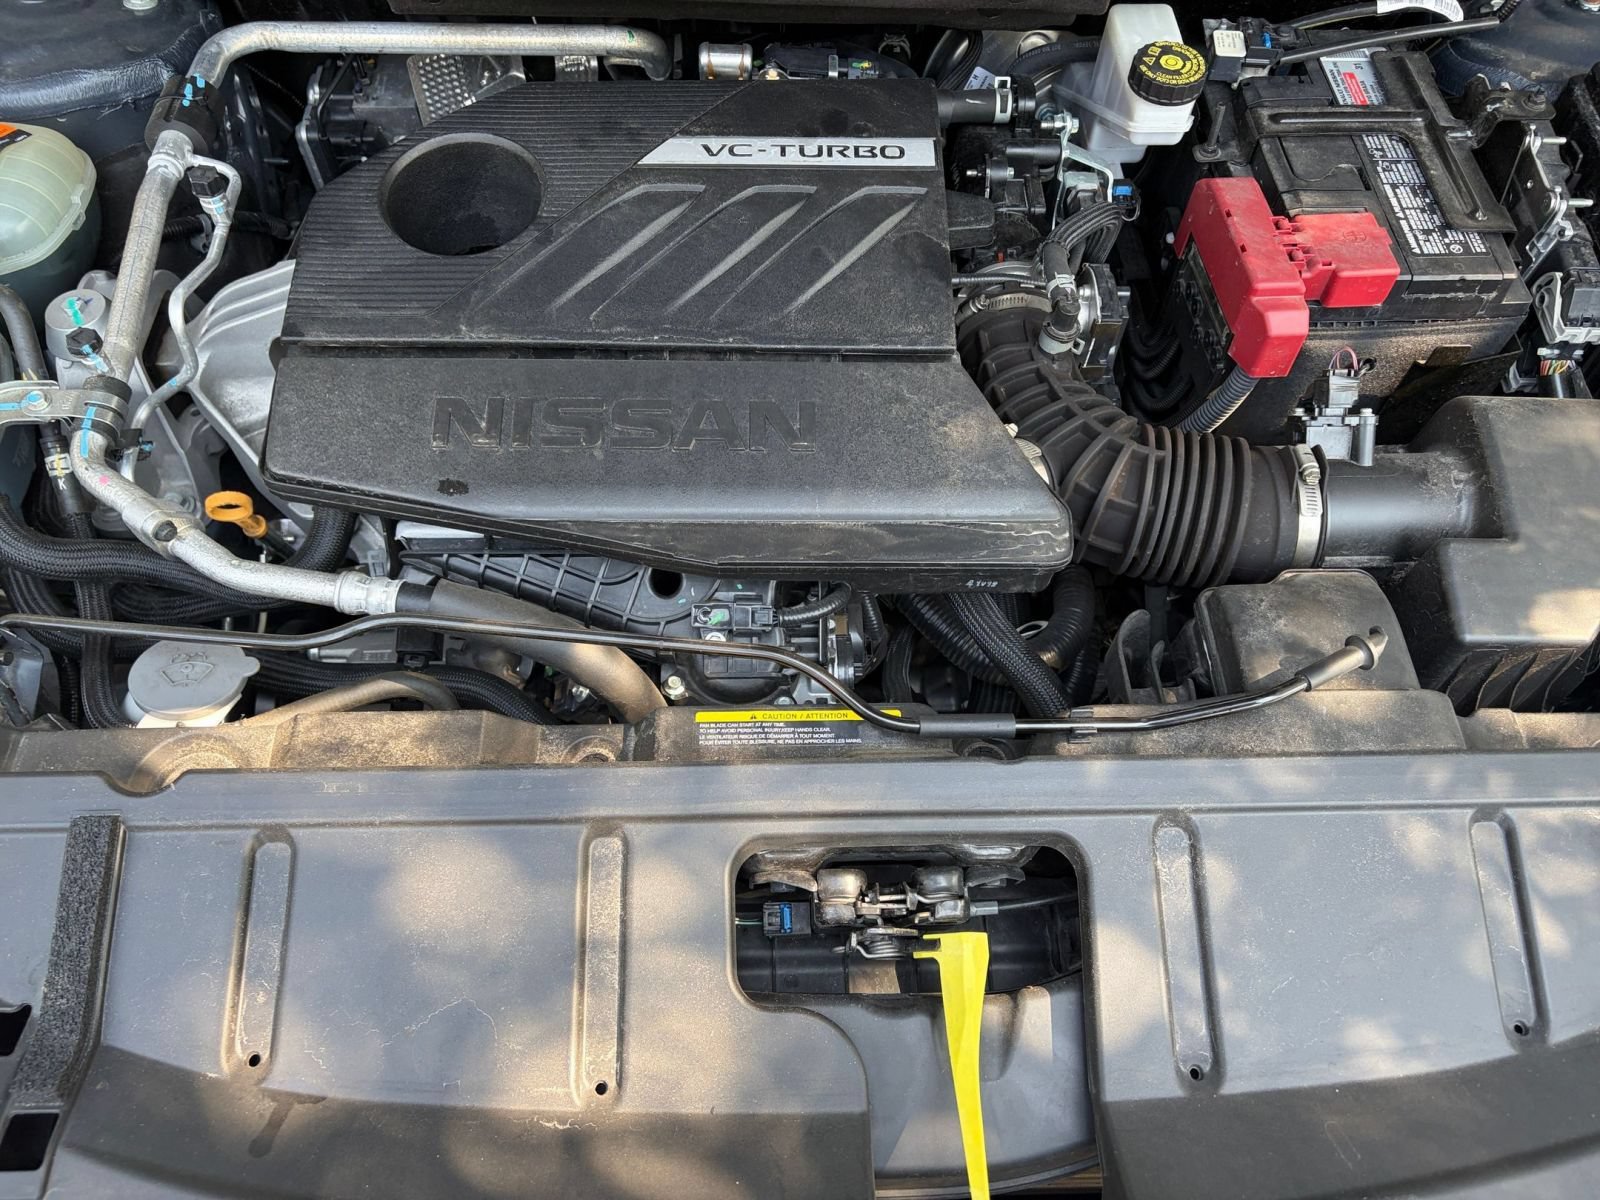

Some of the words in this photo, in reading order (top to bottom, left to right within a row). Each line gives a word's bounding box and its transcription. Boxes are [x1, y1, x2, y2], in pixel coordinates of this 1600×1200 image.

[1156, 72, 1173, 80] CLEAN
[701, 143, 906, 160] VC-TURBO
[431, 397, 817, 452] NISSAN
